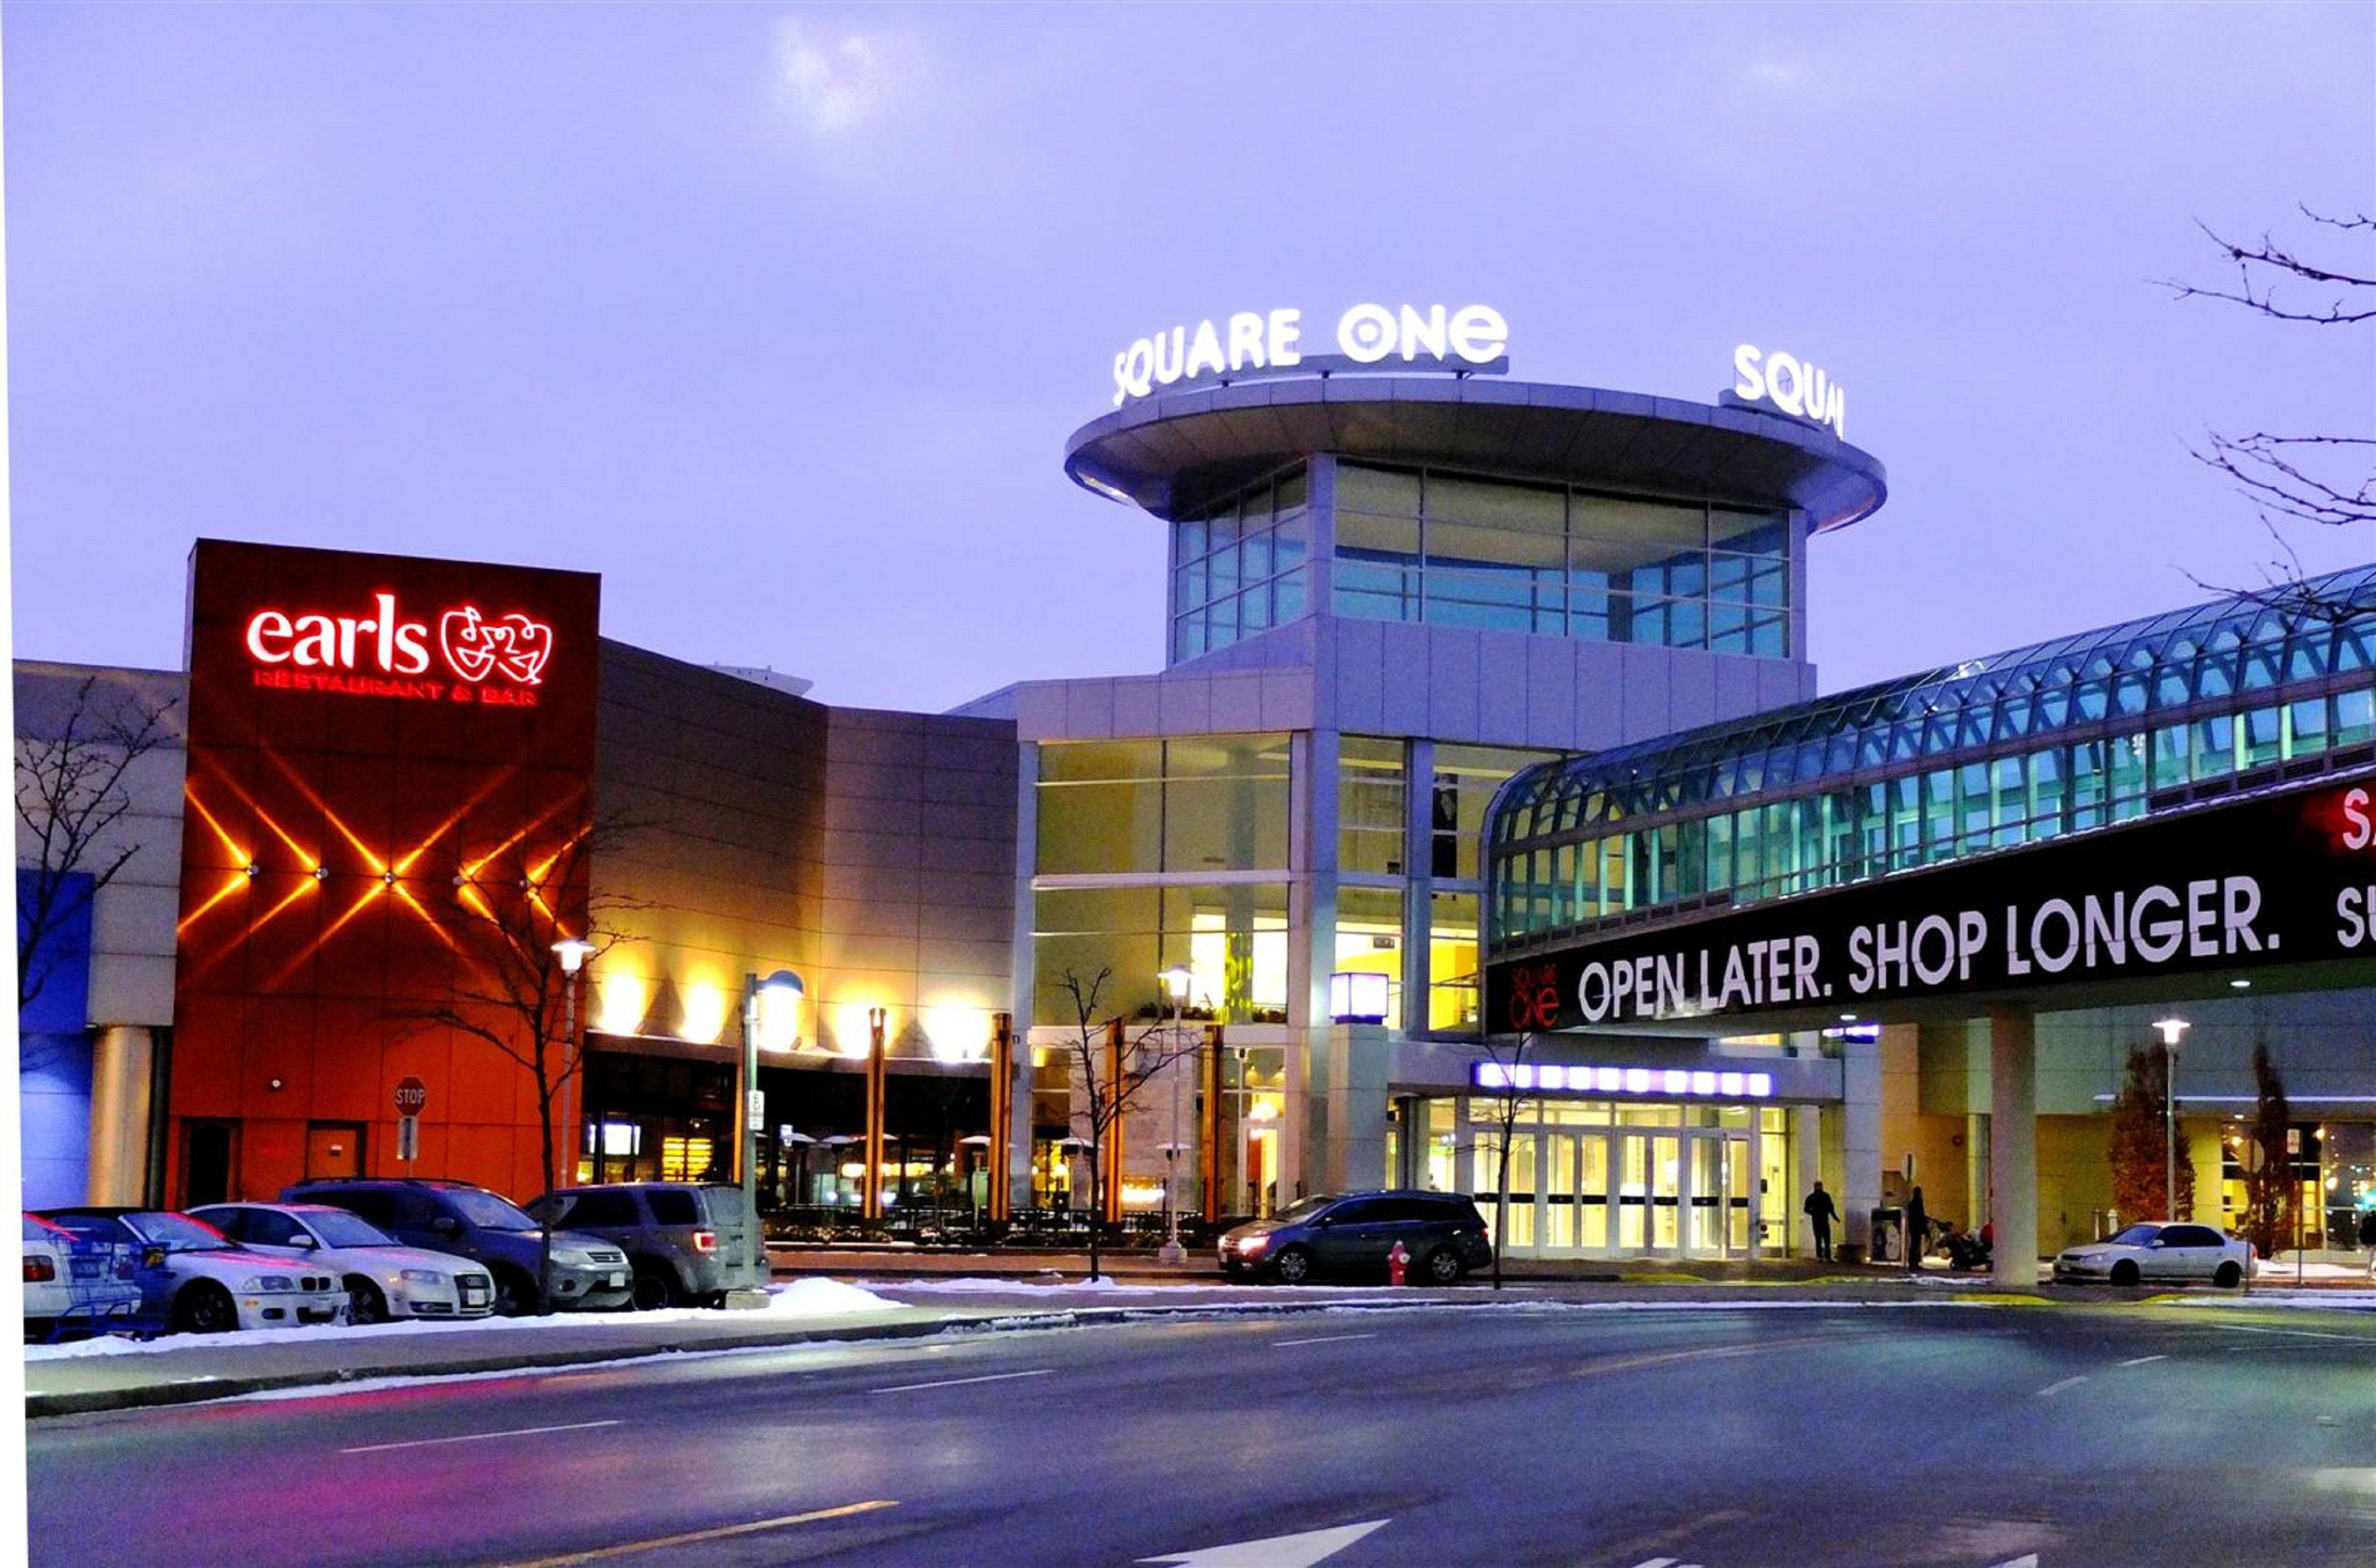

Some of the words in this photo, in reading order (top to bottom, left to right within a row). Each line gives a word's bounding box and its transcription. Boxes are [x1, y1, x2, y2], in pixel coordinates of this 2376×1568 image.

[1113, 308, 1301, 407] SQUARE
[247, 593, 430, 674] earls
[254, 669, 444, 701] RESTAURANT
[452, 684, 471, 702] &
[481, 686, 538, 707] BAR
[2343, 788, 2376, 850] S
[1578, 952, 1685, 1022] OPEN
[1700, 935, 1832, 1010] LATER.
[1848, 910, 1988, 994] SHOP
[2007, 876, 2280, 975] LONGER.
[396, 1088, 425, 1104] STOP
